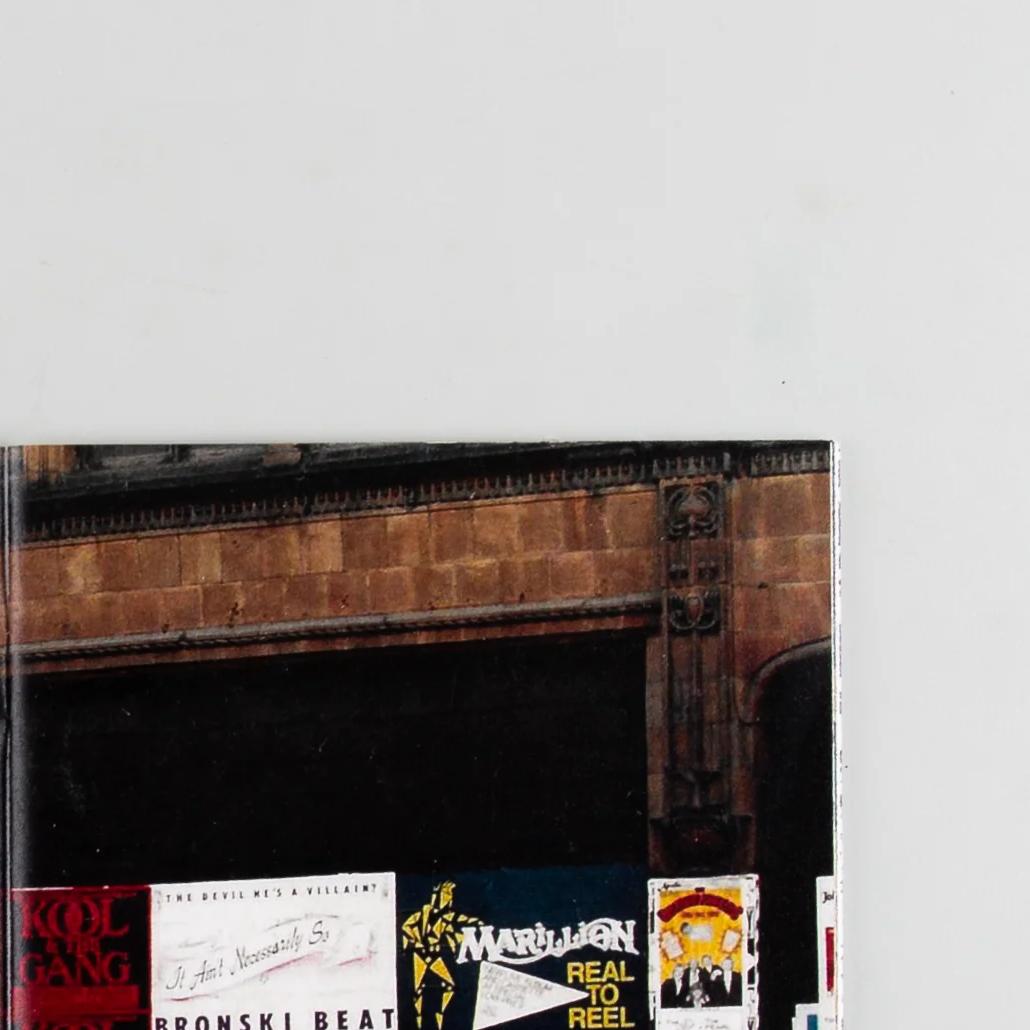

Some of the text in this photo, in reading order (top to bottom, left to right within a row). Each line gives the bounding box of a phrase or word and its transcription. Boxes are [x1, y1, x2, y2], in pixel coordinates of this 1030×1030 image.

[166, 883, 377, 903] THE DEVIL HE'S A VILLAIN?
[21, 899, 130, 938] KOOL
[230, 927, 303, 976] Necessarily
[308, 920, 330, 945] So
[456, 918, 639, 965] MARILLION
[20, 952, 131, 985] GANG
[567, 960, 635, 983] REAL
[587, 984, 619, 1006] TO
[568, 1006, 636, 1029] REEL
